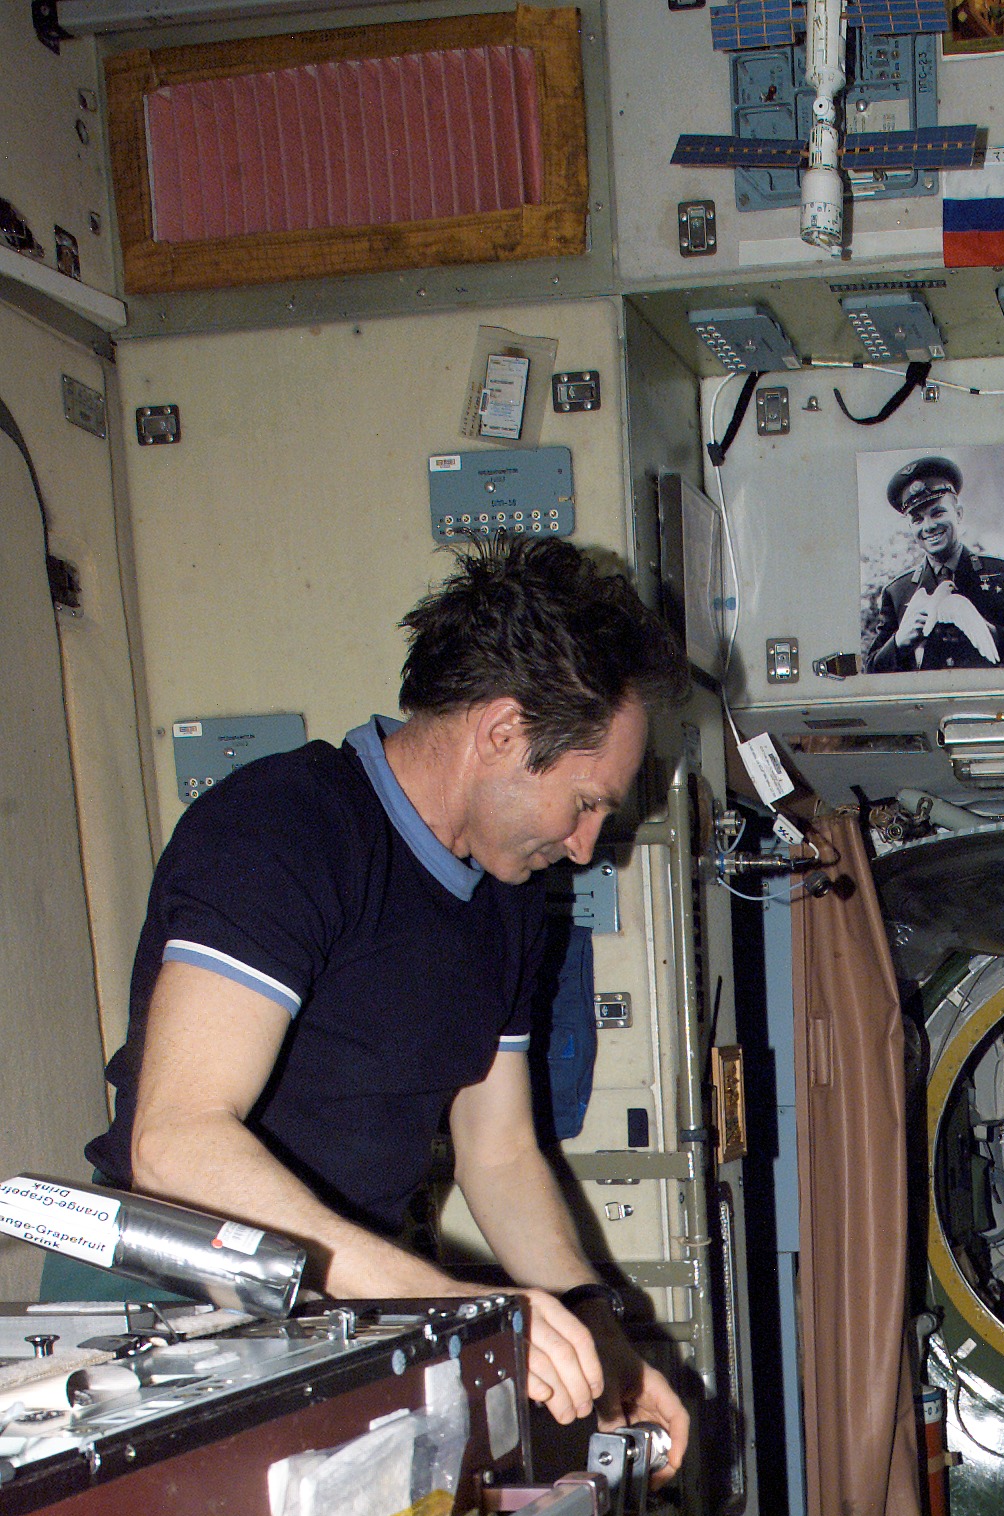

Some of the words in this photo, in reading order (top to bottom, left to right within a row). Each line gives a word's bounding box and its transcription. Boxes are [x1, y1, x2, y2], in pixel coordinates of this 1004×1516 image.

[31, 1182, 71, 1198] Drink
[0, 1184, 110, 1222] Orange-Grapefr
[23, 1231, 61, 1250] Drink
